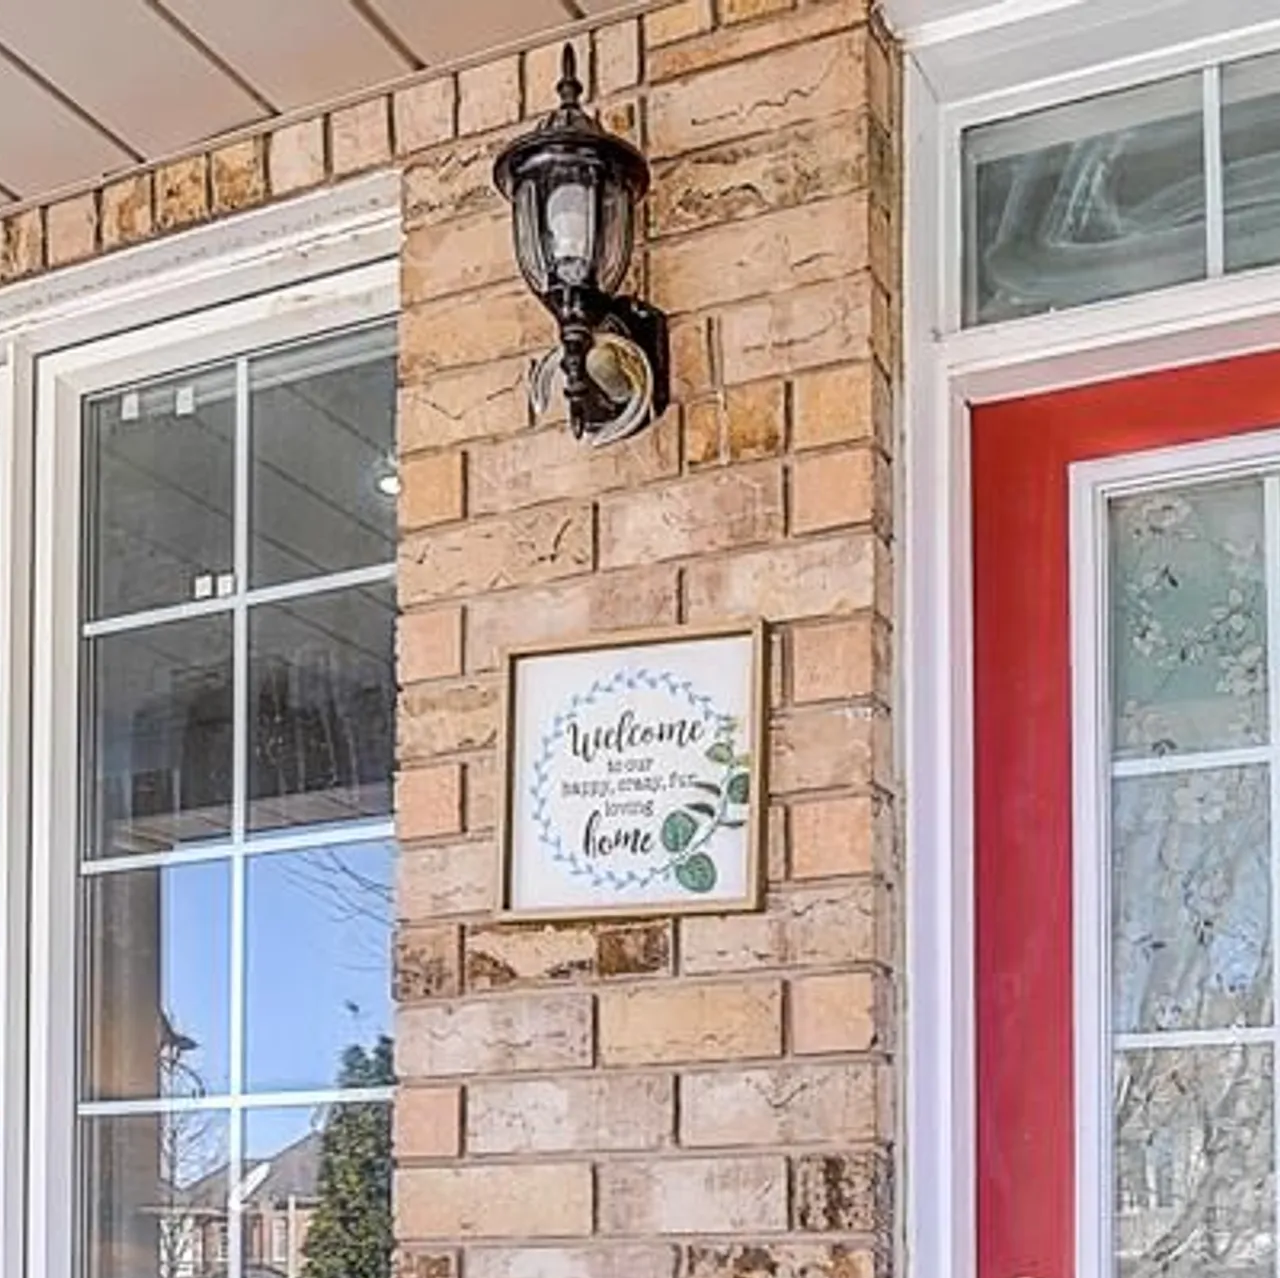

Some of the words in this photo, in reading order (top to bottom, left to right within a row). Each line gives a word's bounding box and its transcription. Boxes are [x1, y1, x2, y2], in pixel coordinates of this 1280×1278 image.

[566, 710, 704, 763] Welcome
[624, 758, 654, 772] our
[605, 800, 654, 817] loving
[583, 810, 654, 858] home
